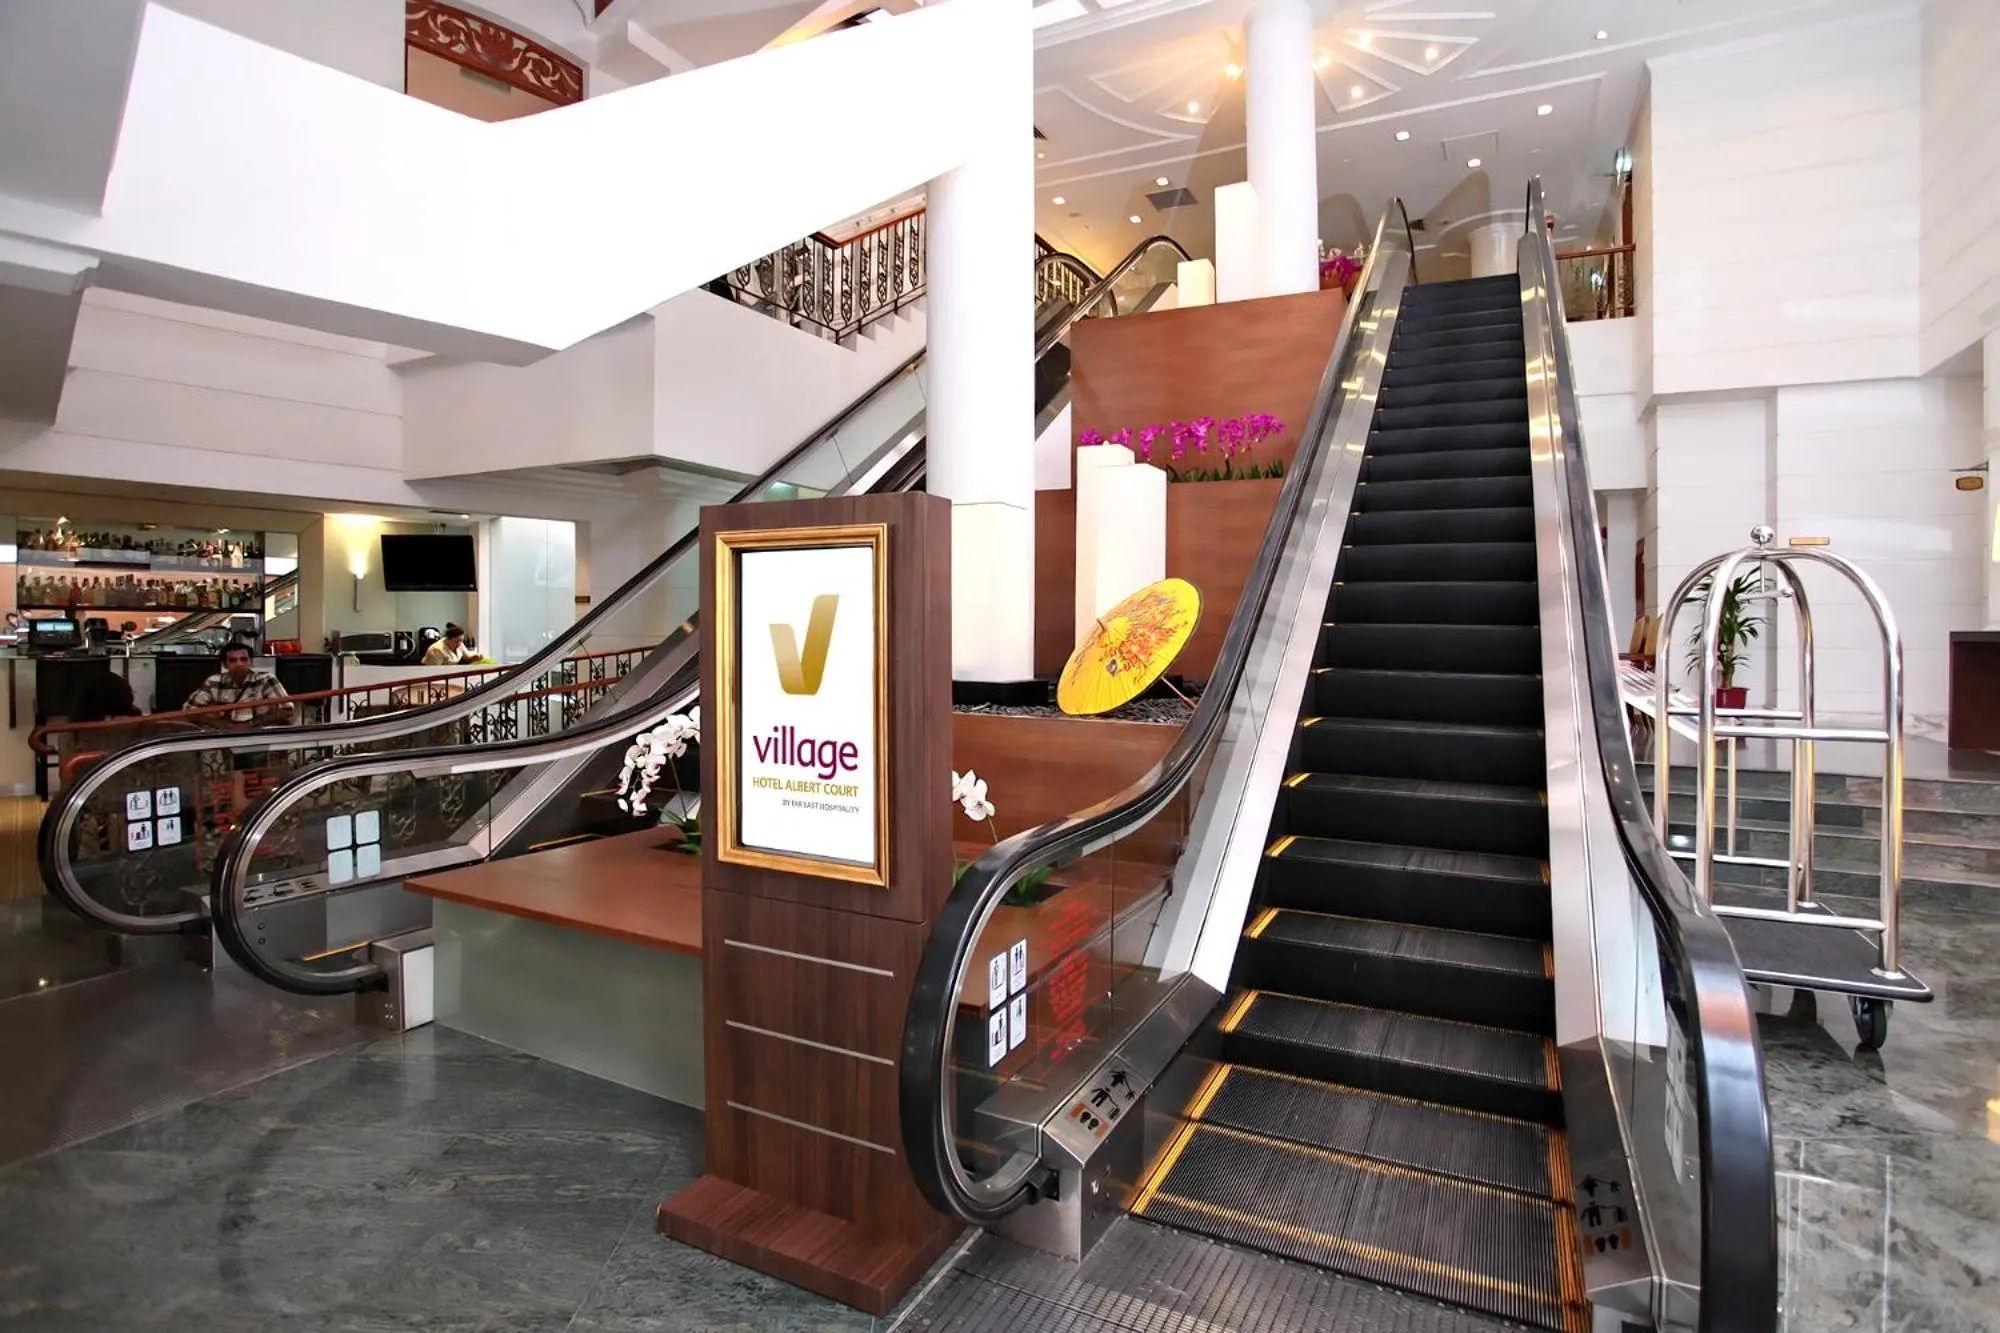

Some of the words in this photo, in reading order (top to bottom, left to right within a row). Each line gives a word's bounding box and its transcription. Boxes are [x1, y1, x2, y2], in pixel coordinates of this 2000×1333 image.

[753, 725, 859, 780] village
[753, 777, 783, 790] HOTEL
[785, 780, 821, 793] ALBERT
[824, 784, 859, 797] COURT
